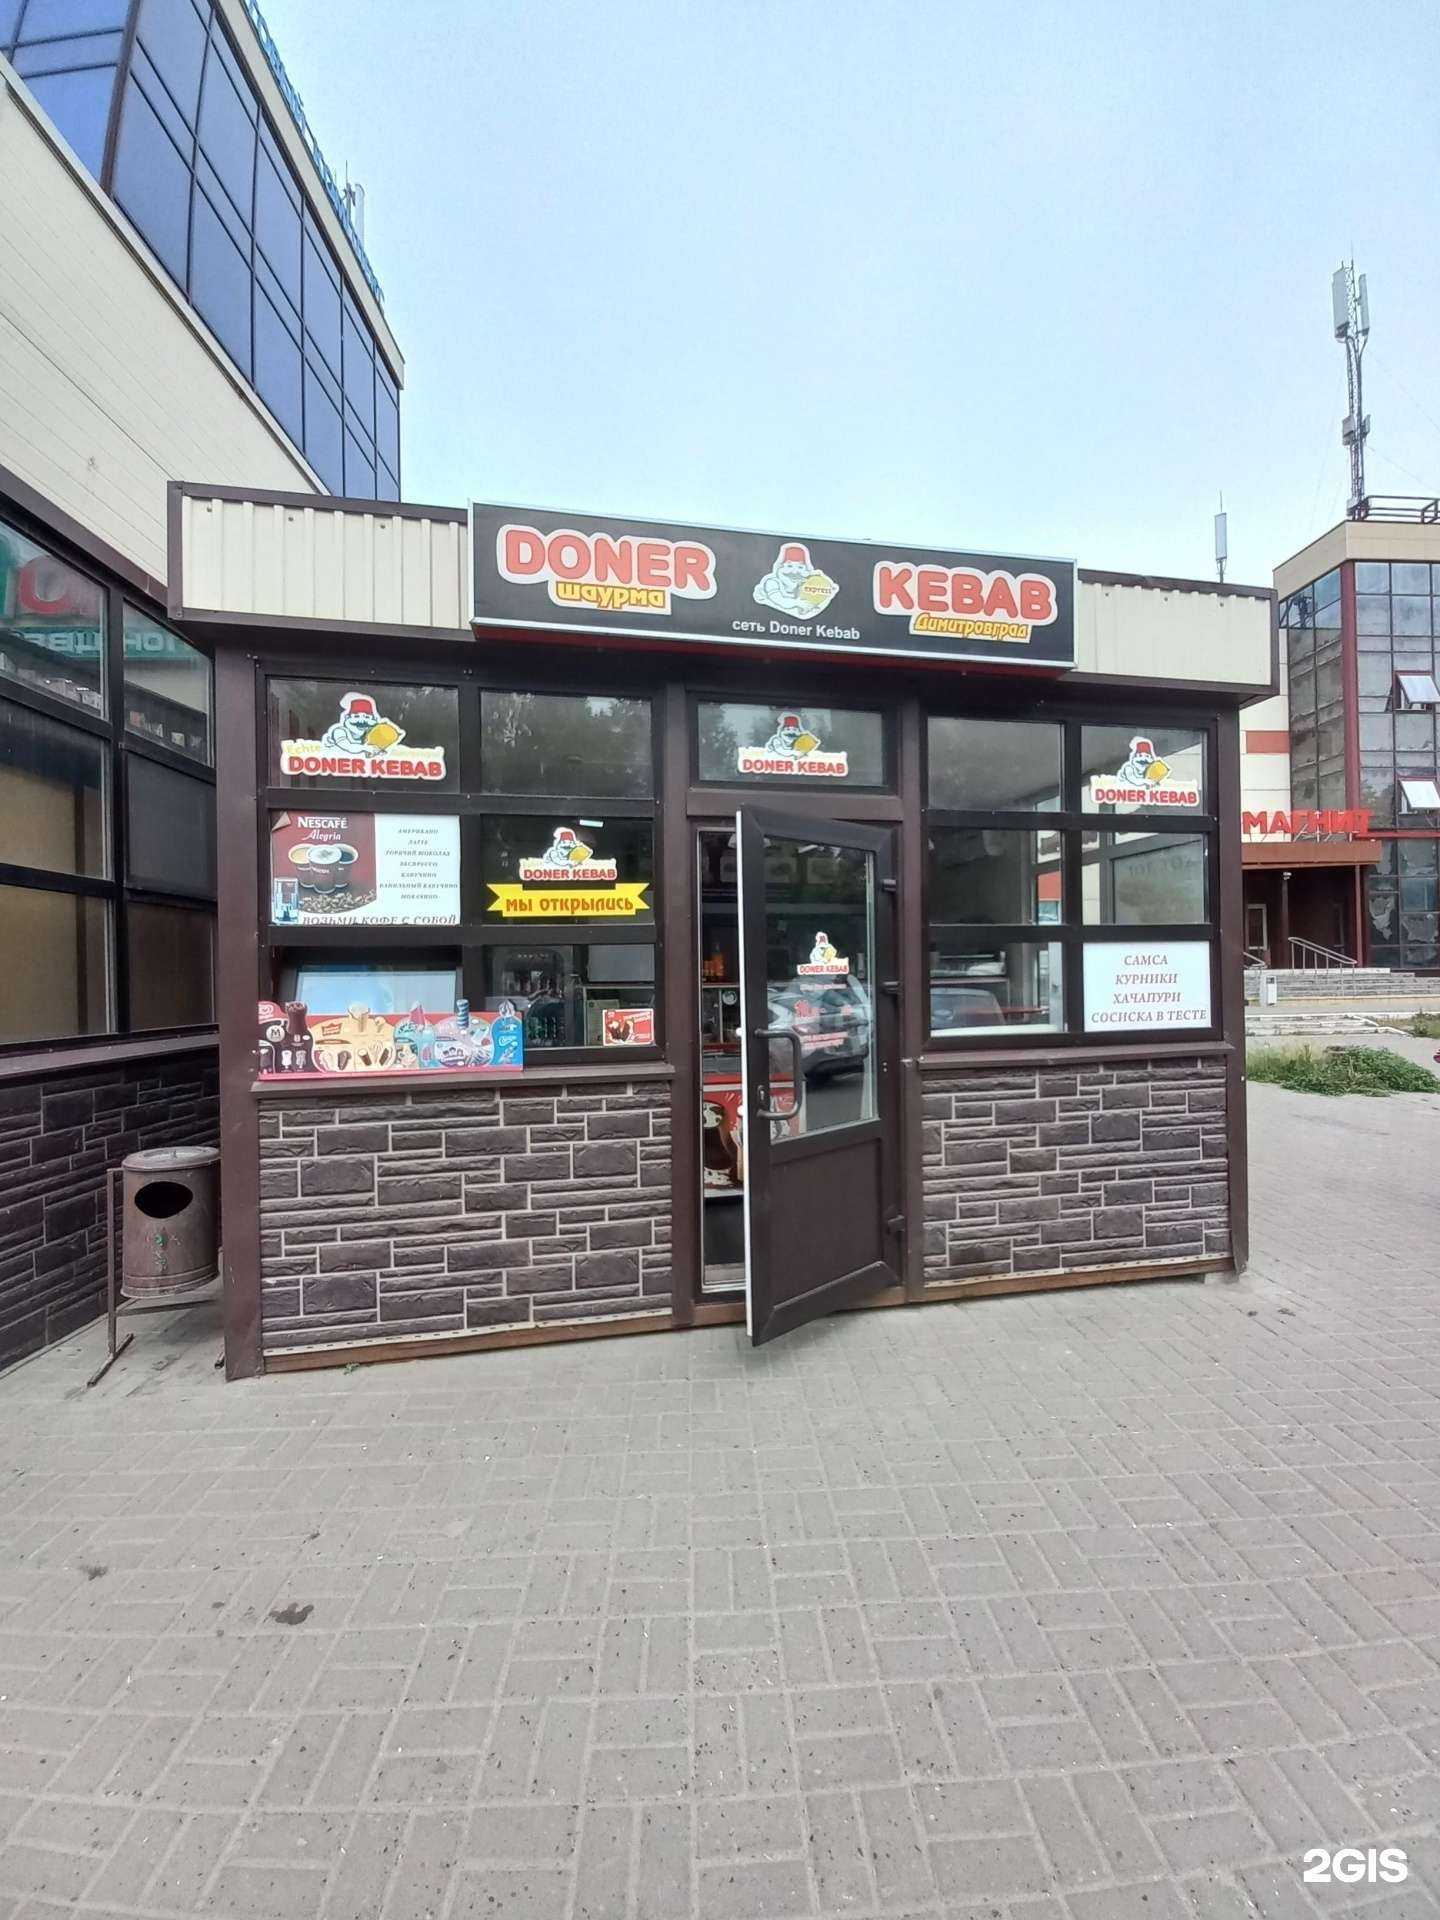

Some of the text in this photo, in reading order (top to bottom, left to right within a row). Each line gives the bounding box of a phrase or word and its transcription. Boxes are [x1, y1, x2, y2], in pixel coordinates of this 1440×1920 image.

[504, 528, 1053, 621] DONER KEBAB
[555, 580, 666, 610] шаурма
[732, 620, 860, 640] сеть Doner Kebab
[913, 612, 1029, 641] Димитровград
[288, 756, 443, 777] DONER KEBAB
[742, 759, 846, 774] DONER KEBAB
[1095, 788, 1198, 804] DONER KEBAB
[297, 816, 348, 829] NESCAFÉ
[1242, 808, 1372, 835] МАГНИТ
[301, 829, 341, 842] Alegria
[523, 869, 616, 879] DONER KEBAB
[302, 916, 357, 925] ВОЗЬМИ
[361, 916, 399, 925] КОФЕ
[413, 914, 457, 925] СОБОЙ
[1124, 954, 1168, 966] САМСА
[1115, 973, 1178, 985] КУРНИКИ
[1113, 991, 1182, 1005] ХАЧАПУРИ
[1091, 1009, 1207, 1024] СОСИСКА В ТЕСТЕ
